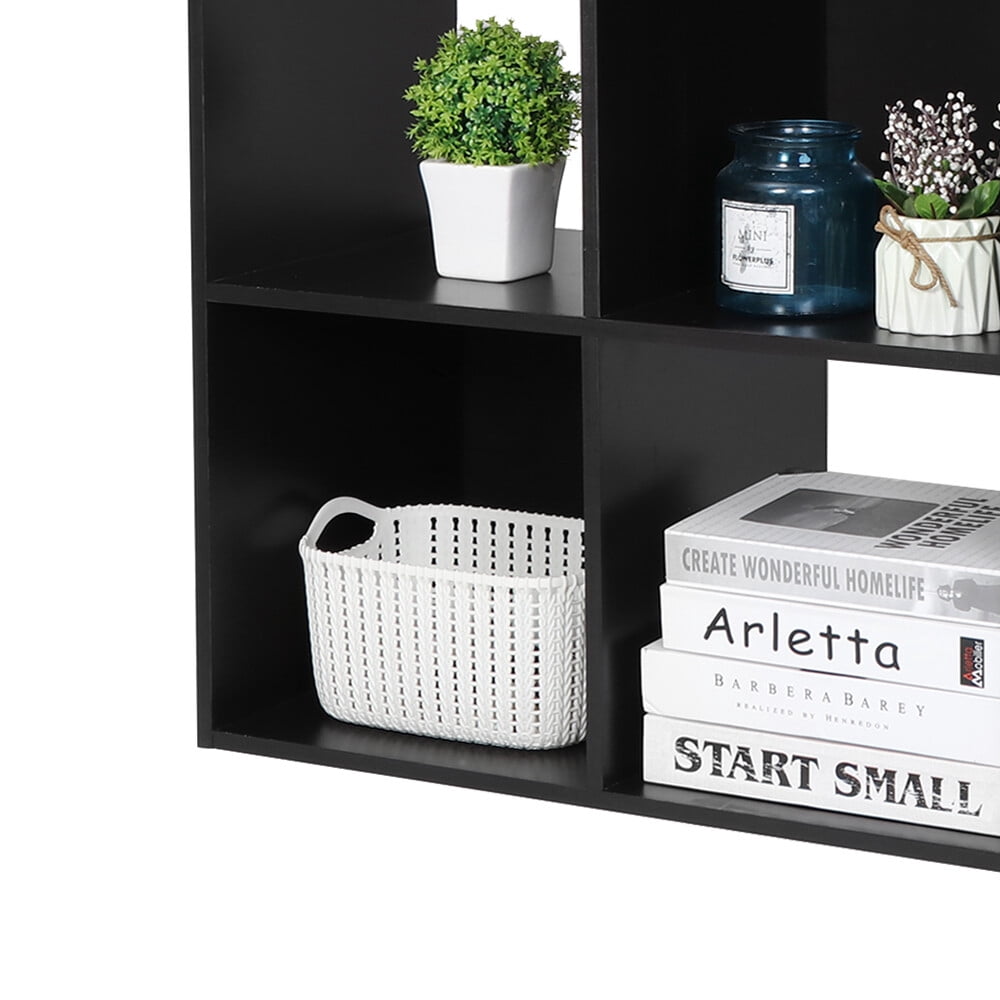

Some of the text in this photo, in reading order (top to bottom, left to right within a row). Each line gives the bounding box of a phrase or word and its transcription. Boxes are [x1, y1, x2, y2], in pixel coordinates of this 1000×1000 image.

[874, 497, 989, 549] WONDERFUL
[682, 547, 925, 601] CREATE WONDERFUL HOMELIFE
[703, 607, 901, 671] Arletta
[714, 673, 925, 717] BARBERA BAREY
[736, 702, 793, 716] REALIZED
[803, 712, 815, 720] BY
[674, 736, 984, 817] START SMALL
